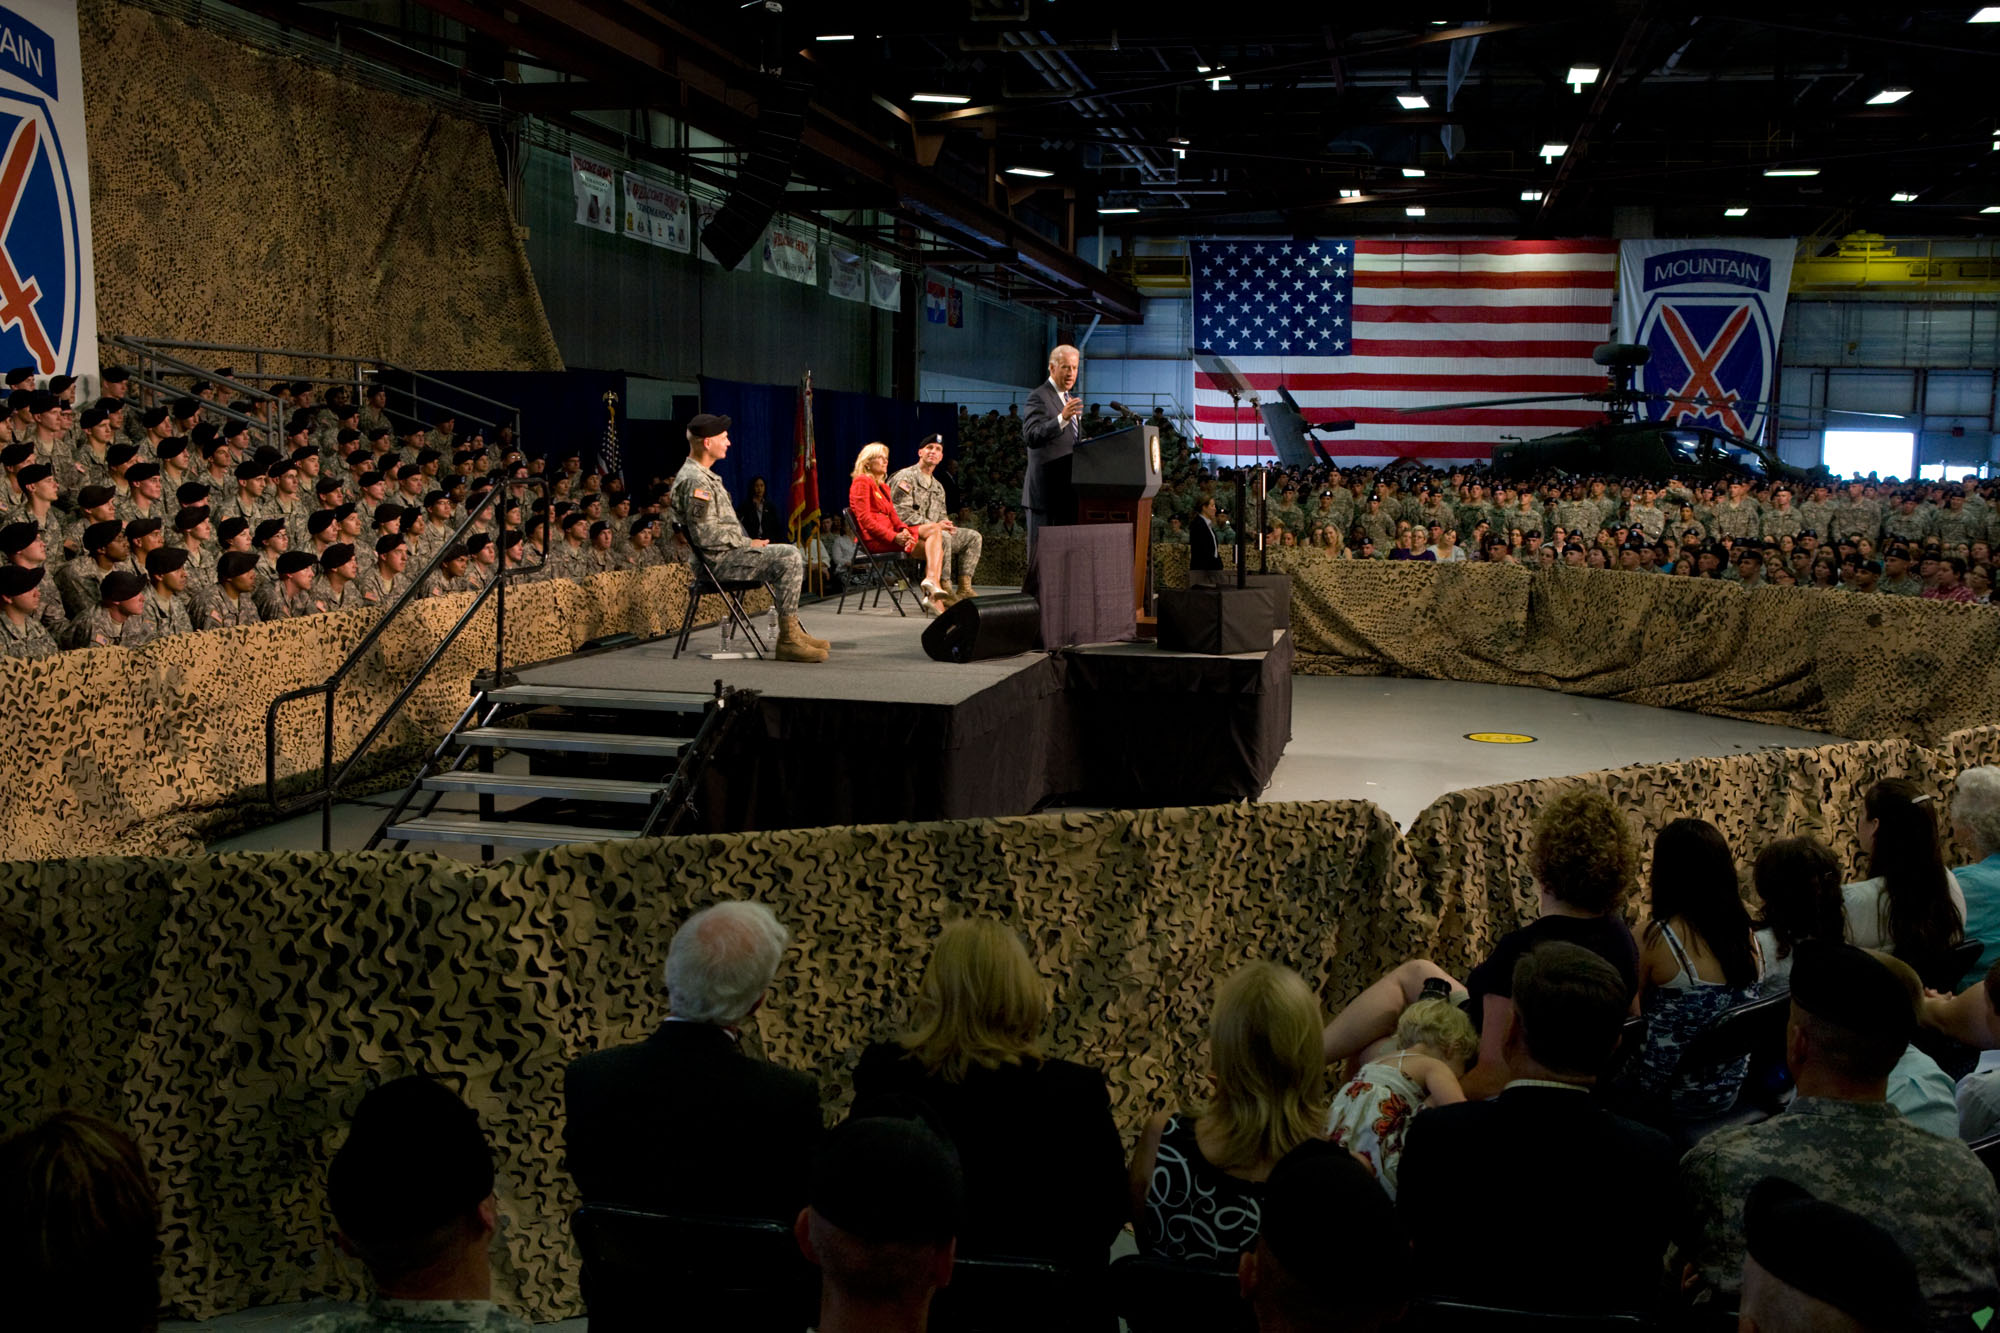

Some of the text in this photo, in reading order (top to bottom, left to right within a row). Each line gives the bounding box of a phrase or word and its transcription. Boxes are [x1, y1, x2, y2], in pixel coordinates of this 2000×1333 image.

[0, 25, 43, 78] AIN
[632, 183, 663, 202] WELCOME
[636, 202, 674, 221] COMMANDOS
[1654, 258, 1759, 281] MOUNTAIN
